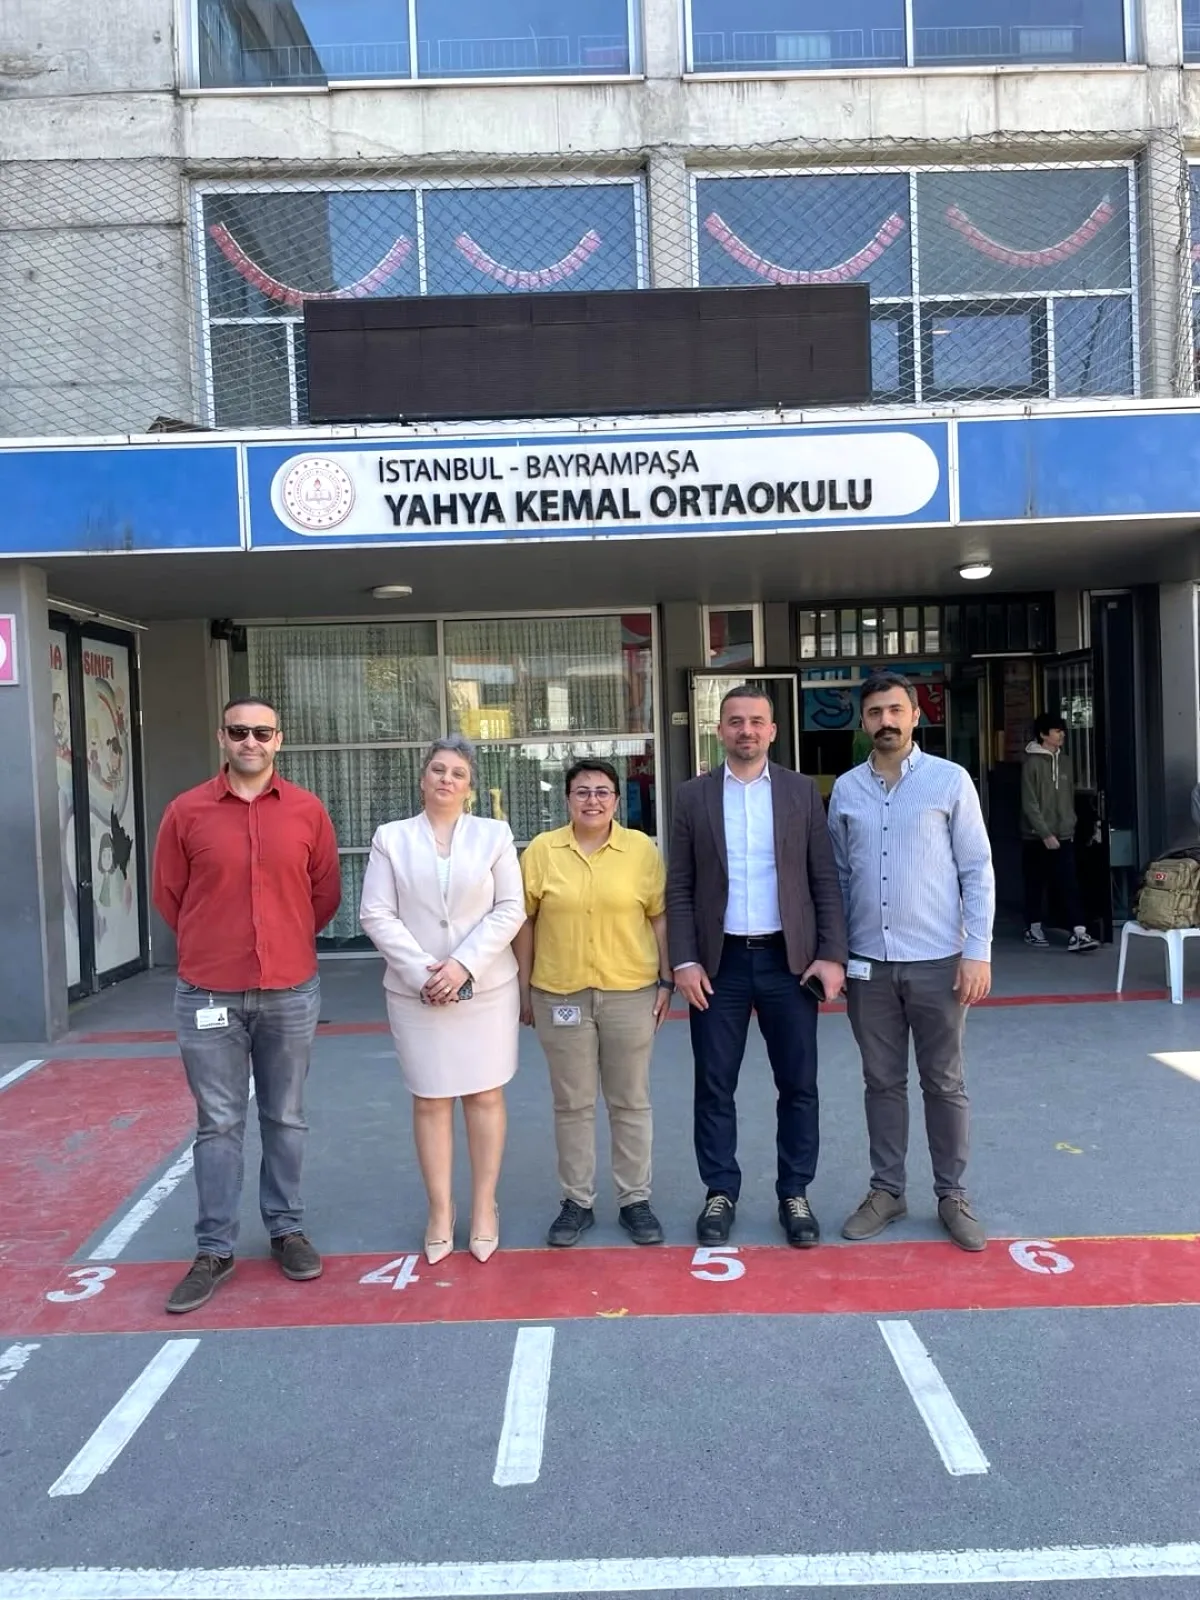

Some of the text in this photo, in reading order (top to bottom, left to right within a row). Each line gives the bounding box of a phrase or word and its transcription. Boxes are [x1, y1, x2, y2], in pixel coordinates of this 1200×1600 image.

[379, 456, 503, 483] İSTANBUL
[527, 450, 699, 480] BAYRAMPAŞA
[384, 478, 872, 526] YAHYA KEMAL ORTAOKULU
[359, 1254, 420, 1290] 4
[690, 1246, 746, 1282] 5
[1008, 1240, 1074, 1274] 6
[46, 1266, 116, 1302] 3
